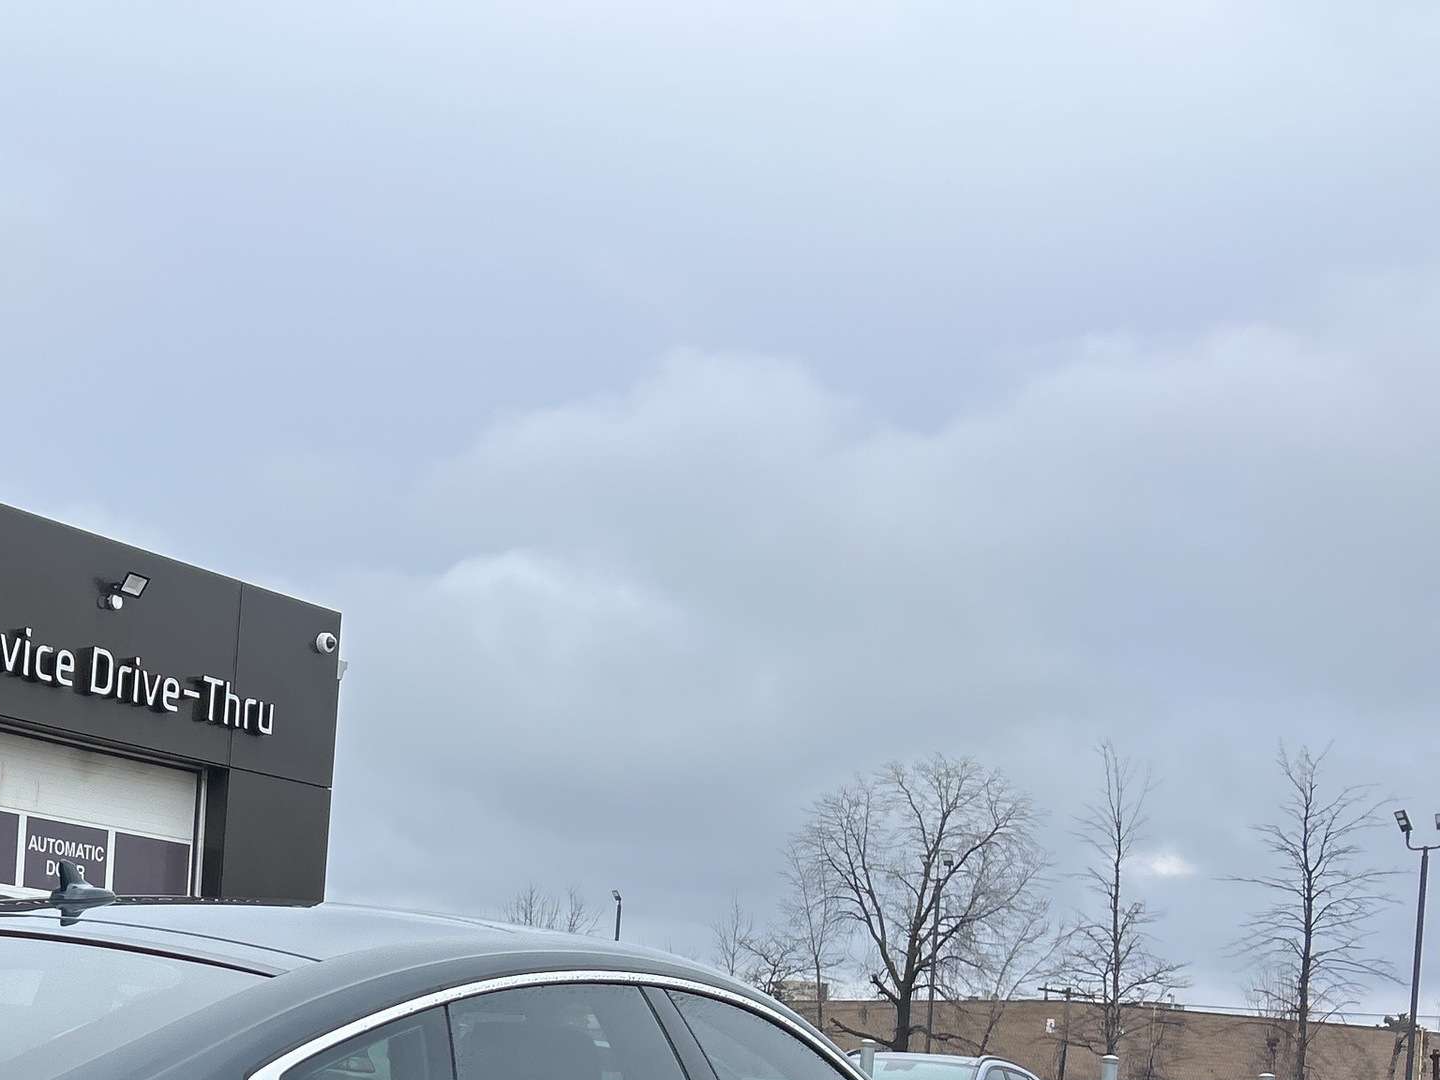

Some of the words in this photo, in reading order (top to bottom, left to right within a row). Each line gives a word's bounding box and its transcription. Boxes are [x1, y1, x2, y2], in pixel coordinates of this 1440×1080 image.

[90, 646, 274, 735] Drive-Thru
[28, 835, 104, 862] AUTOMATIC
[46, 860, 85, 880] DR
